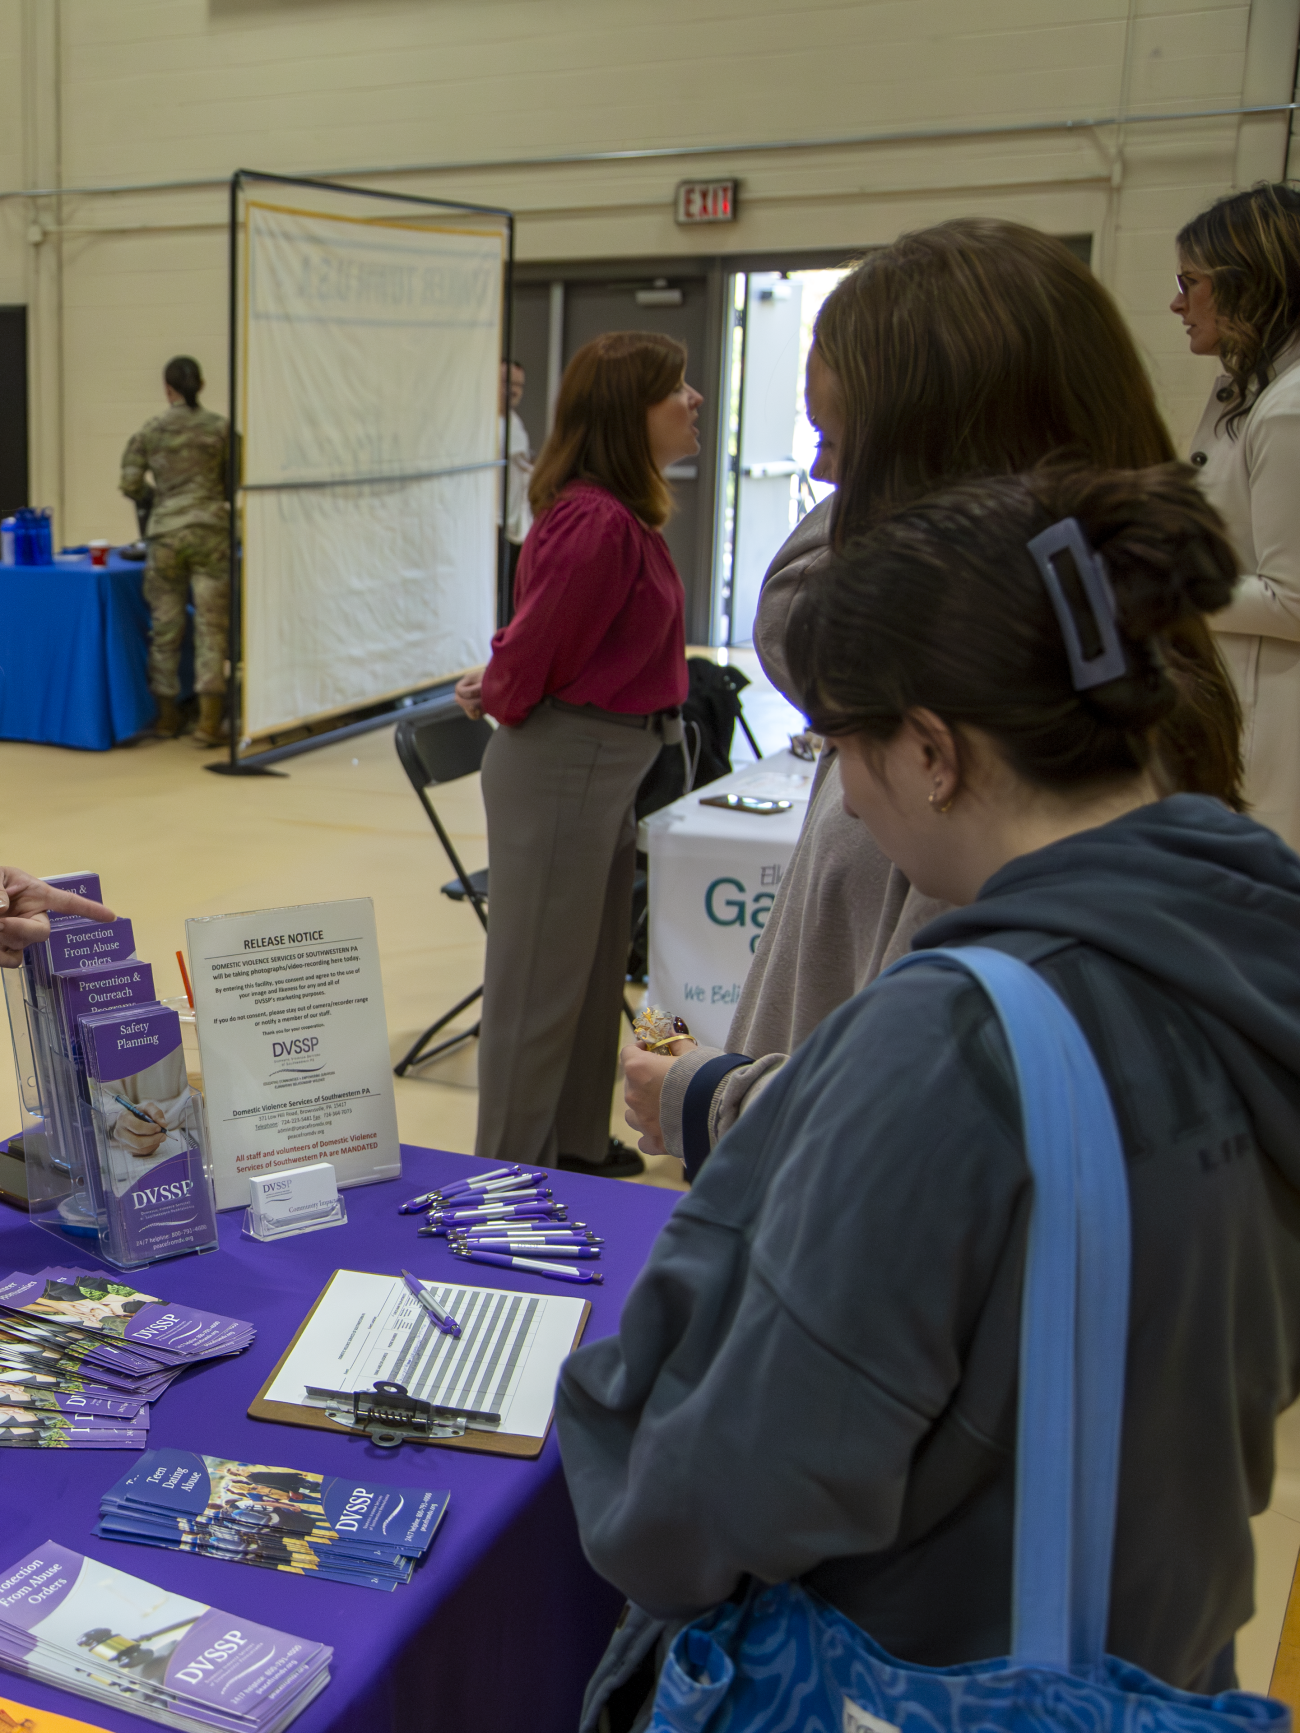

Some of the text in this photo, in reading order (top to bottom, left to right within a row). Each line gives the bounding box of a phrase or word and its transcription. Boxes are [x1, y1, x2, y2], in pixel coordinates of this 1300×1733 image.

[684, 186, 730, 218] EXIT
[79, 885, 87, 894] &
[66, 929, 113, 944] Protection
[244, 930, 324, 950] RELEASE NOTICE
[64, 941, 120, 958] From Abuse
[212, 959, 241, 971] DOMESTIC
[242, 956, 270, 967] VIOLENCE
[270, 953, 296, 963] SERVICES
[305, 946, 350, 958] SOUTHWESTERN
[80, 956, 112, 968] Orders
[213, 972, 223, 980] will
[232, 969, 249, 979] taking
[331, 956, 343, 965] here
[79, 972, 141, 992] Prevention &
[223, 983, 244, 993] entering
[245, 981, 254, 989] this
[275, 978, 284, 986] you
[285, 976, 304, 984] consent
[305, 973, 315, 981] and
[315, 972, 329, 980] agree
[336, 969, 345, 977] the
[239, 991, 250, 999] your
[251, 988, 267, 997] image
[267, 986, 278, 995] and
[278, 984, 298, 993] likeness
[307, 982, 316, 990] any
[88, 987, 133, 1003] Outreach
[254, 996, 276, 1005] DVSSP's
[276, 992, 301, 1002] marketing
[683, 982, 705, 1002] We
[218, 1017, 229, 1025] you
[237, 1013, 246, 1021] not
[268, 1008, 285, 1017] please
[285, 1007, 297, 1015] stay
[312, 999, 354, 1010] camera/recorder
[354, 996, 369, 1004] range
[261, 1018, 277, 1027] notify
[282, 1015, 303, 1023] member
[120, 1022, 150, 1035] Safety
[117, 1034, 159, 1050] Planning
[272, 1036, 319, 1057] DVSSP
[232, 1105, 260, 1117] Domestic
[262, 1101, 287, 1112] Violence
[288, 1098, 313, 1108] Services
[321, 1089, 360, 1102] Southwestern
[236, 1132, 377, 1163] All staff and volunteers of Domestic Violence
[236, 1162, 264, 1173] Services
[265, 1160, 272, 1169] of
[273, 1153, 318, 1167] Southwestern
[319, 1150, 328, 1159] PA
[340, 1142, 378, 1155] MANDATED
[131, 1180, 193, 1209] DVSSP
[262, 1179, 292, 1193] DVSSP
[131, 1313, 180, 1340] DVSSP
[146, 1467, 167, 1483] Teen
[162, 1466, 189, 1489] Dating
[180, 1471, 201, 1492] Abuse
[334, 1487, 375, 1532] DVSSP
[29, 1563, 62, 1588] Abuse
[27, 1578, 67, 1604] Orders
[174, 1630, 248, 1684] DVSSP
